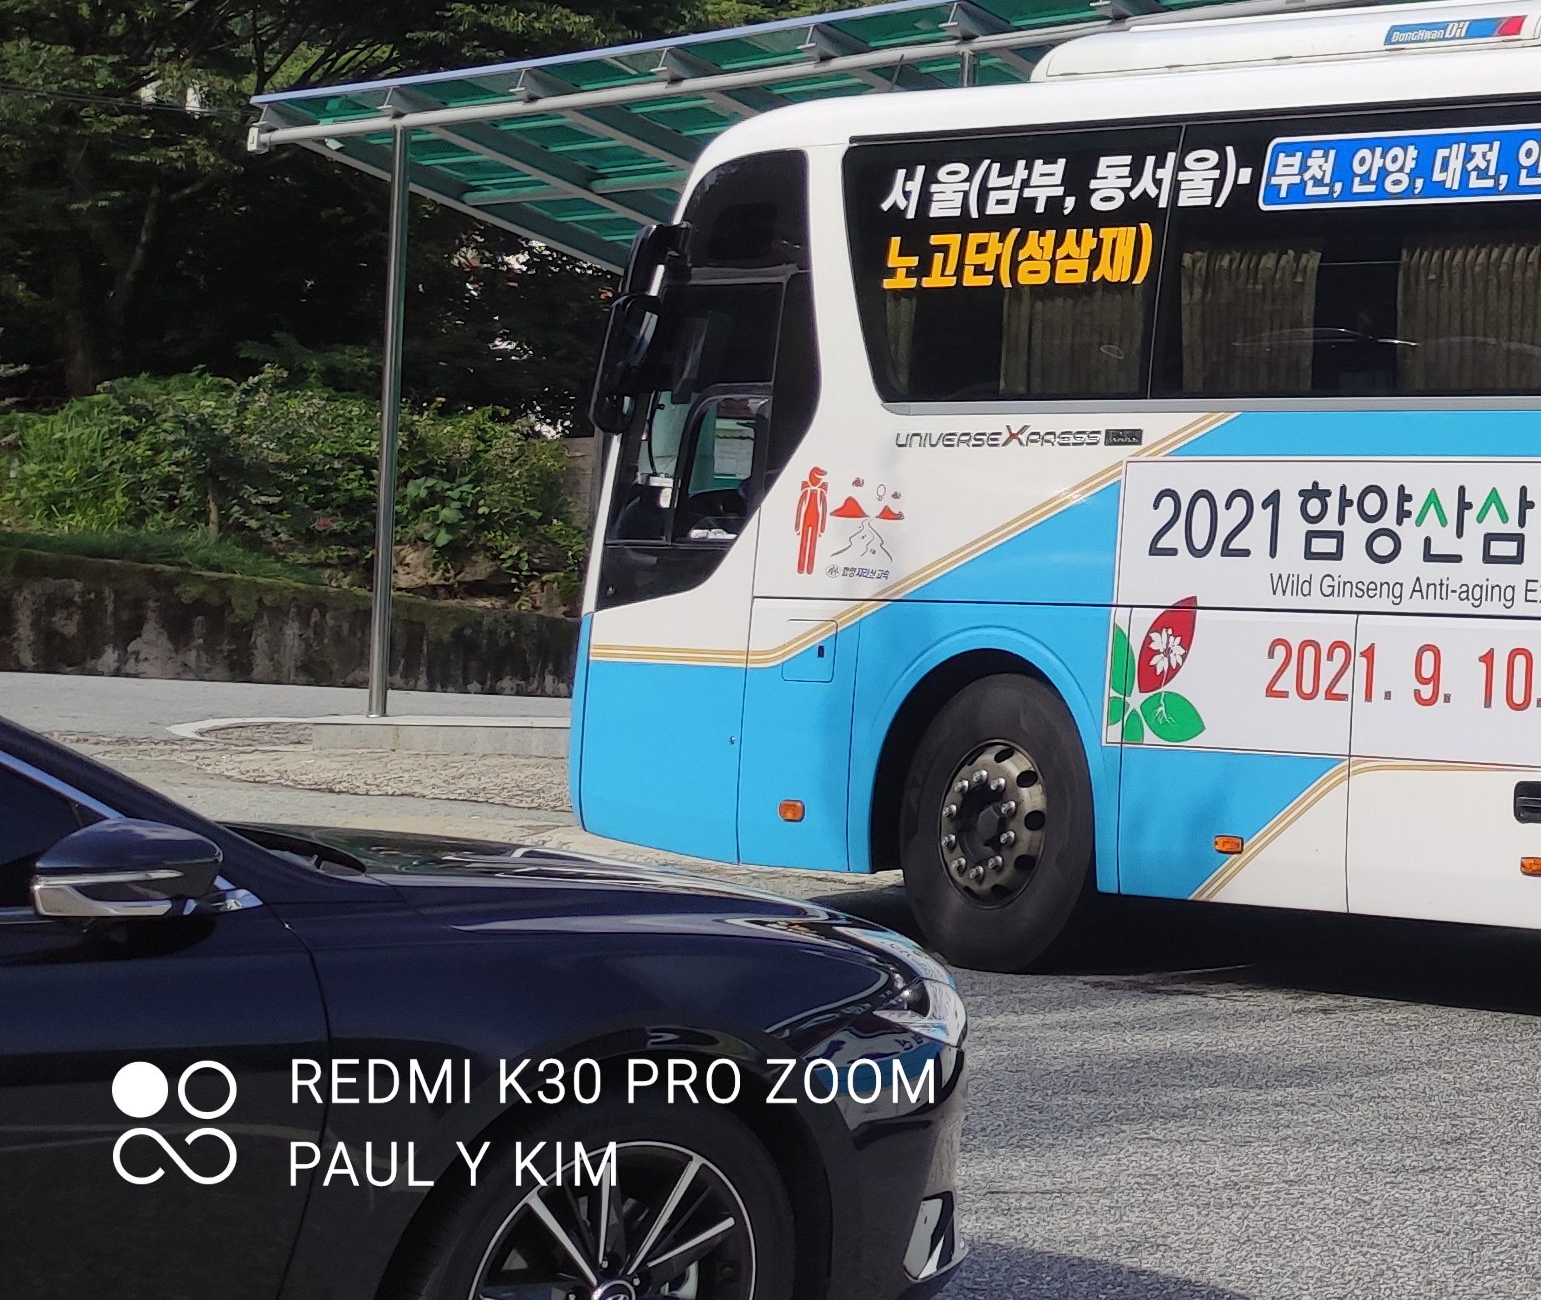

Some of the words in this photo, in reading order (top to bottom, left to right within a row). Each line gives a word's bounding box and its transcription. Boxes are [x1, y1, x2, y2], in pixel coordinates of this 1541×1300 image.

[882, 223, 1153, 290] 노고단(성삼재)
[1270, 573, 1315, 599] Wild
[1320, 574, 1404, 607] Ginseng
[1410, 576, 1516, 611] Anti-aging
[1265, 637, 1393, 701] 2021.
[1413, 644, 1452, 707] 9.
